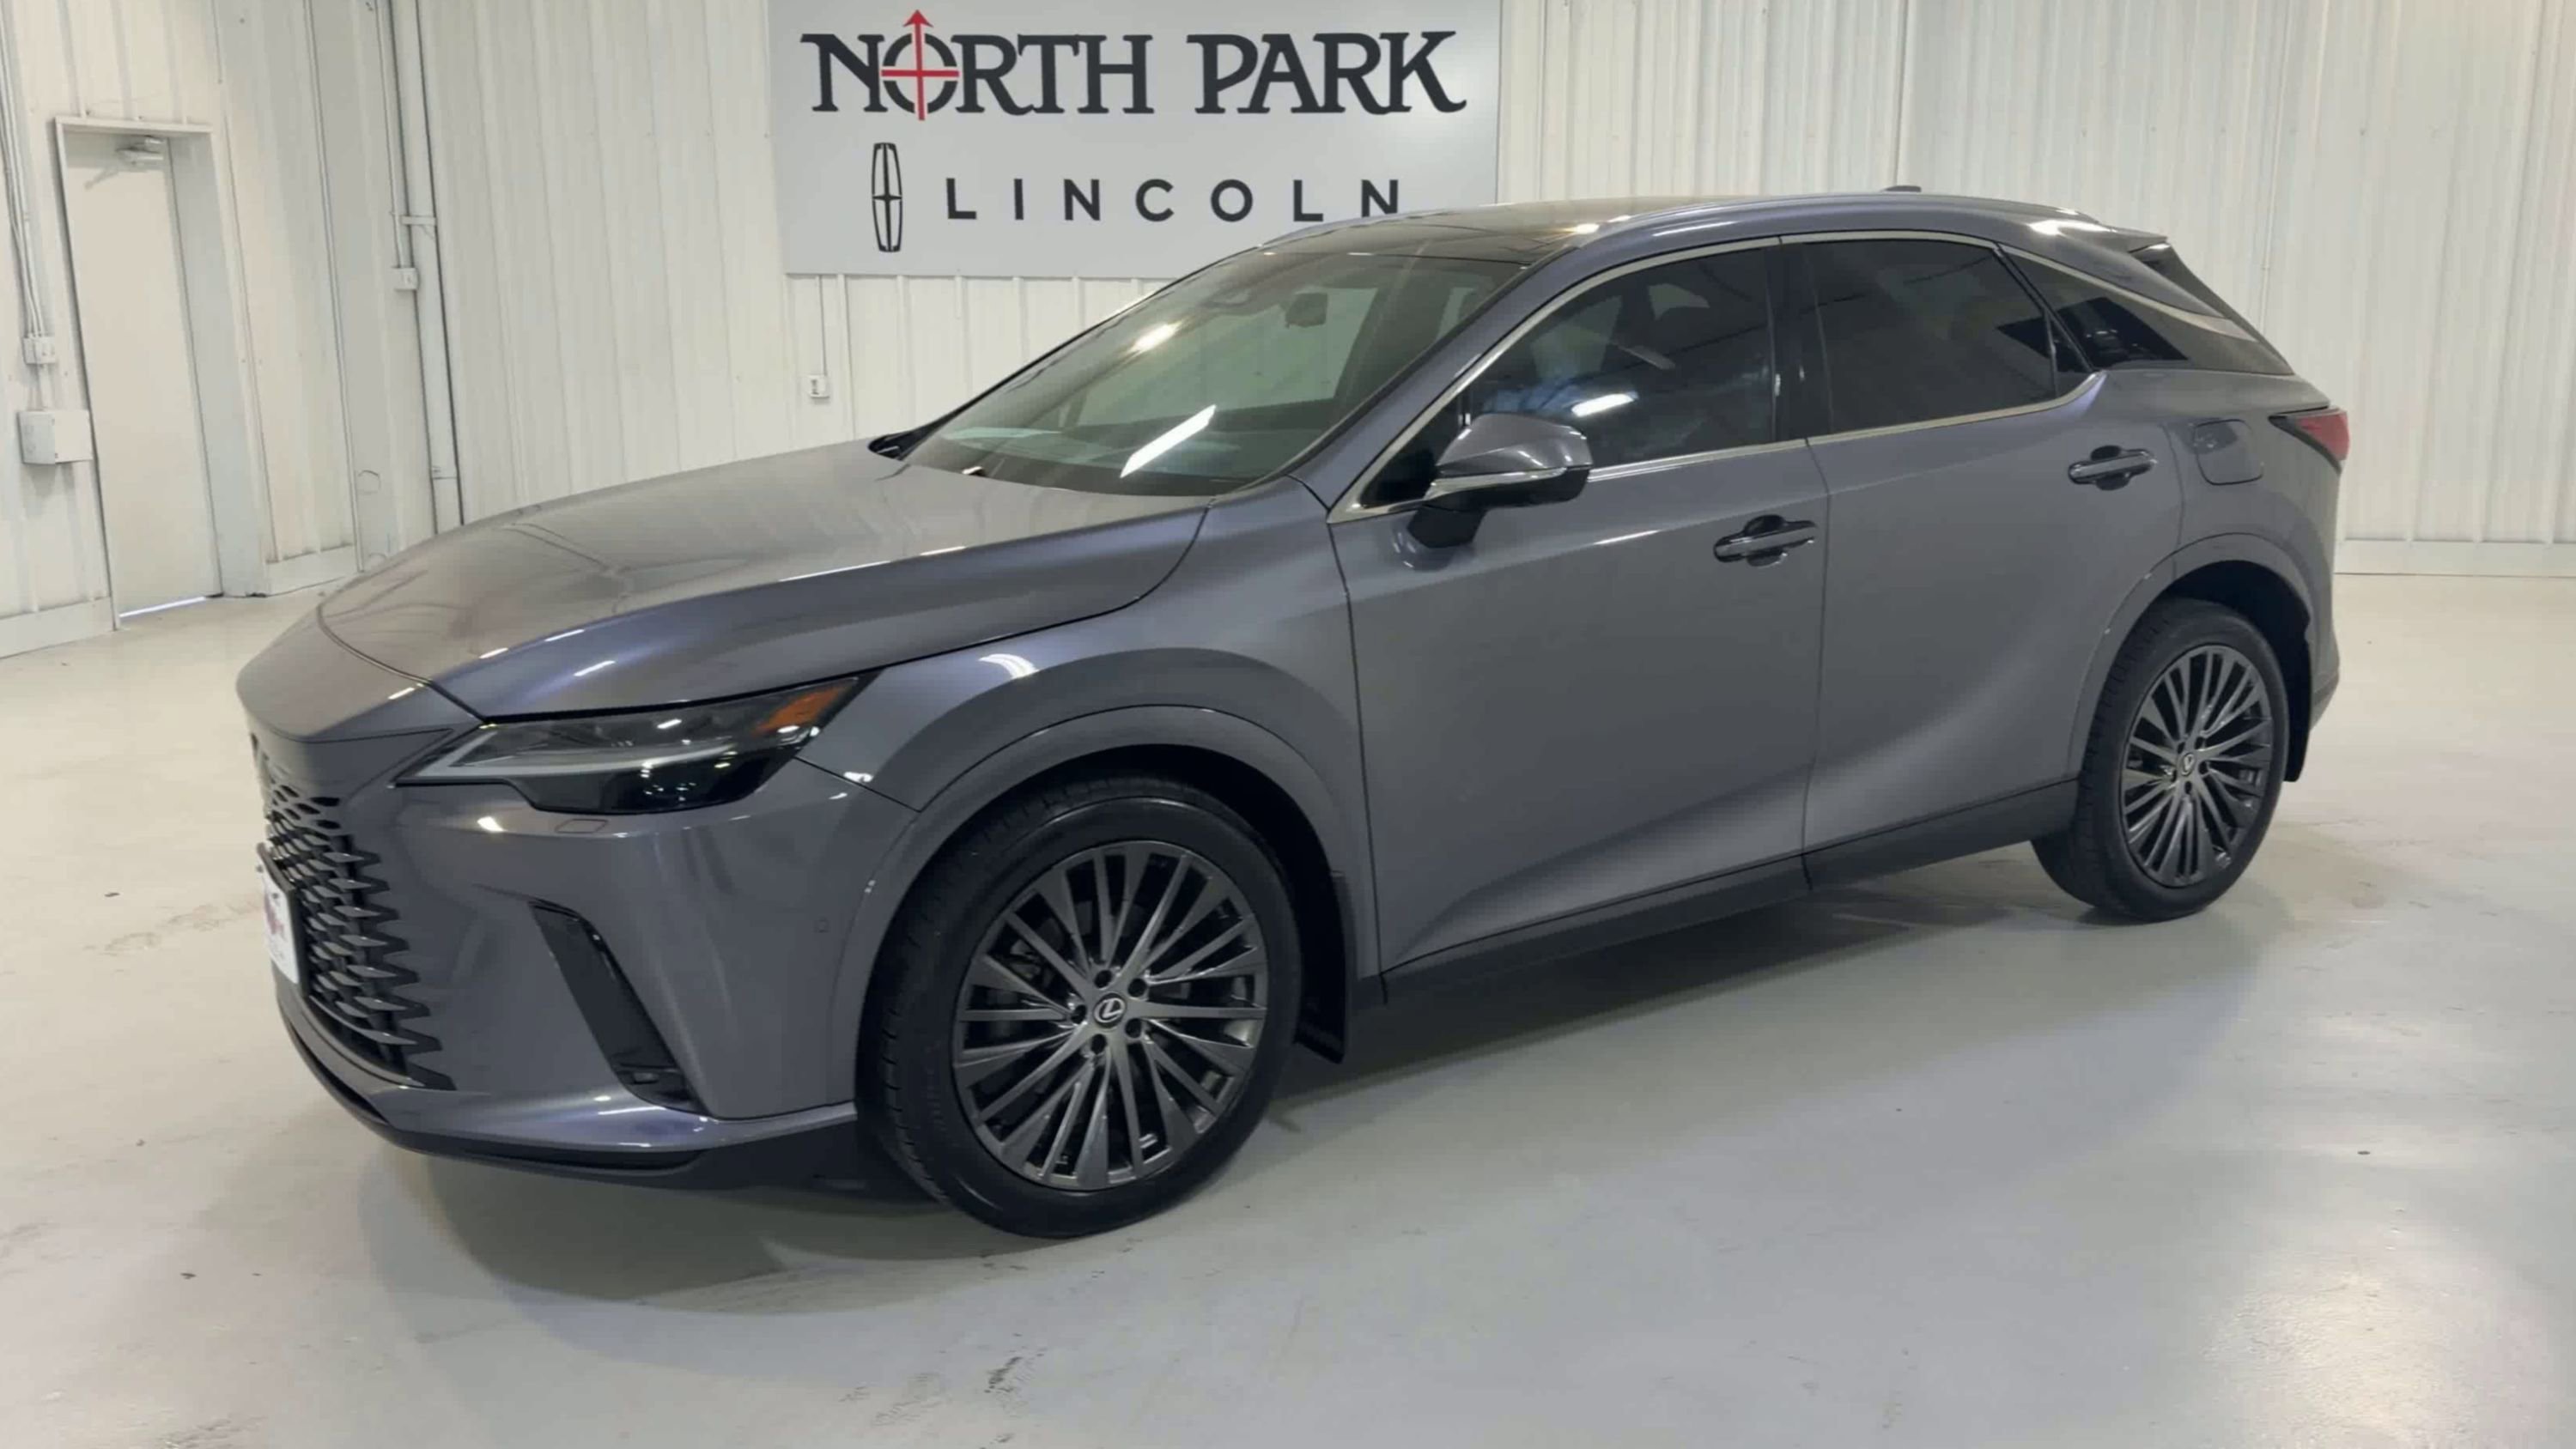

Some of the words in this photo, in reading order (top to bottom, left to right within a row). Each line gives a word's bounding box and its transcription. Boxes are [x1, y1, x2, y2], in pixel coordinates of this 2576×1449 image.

[800, 33, 1154, 117] NORTH
[1187, 31, 1467, 115] PARK
[946, 178, 1399, 222] LINCOLN
